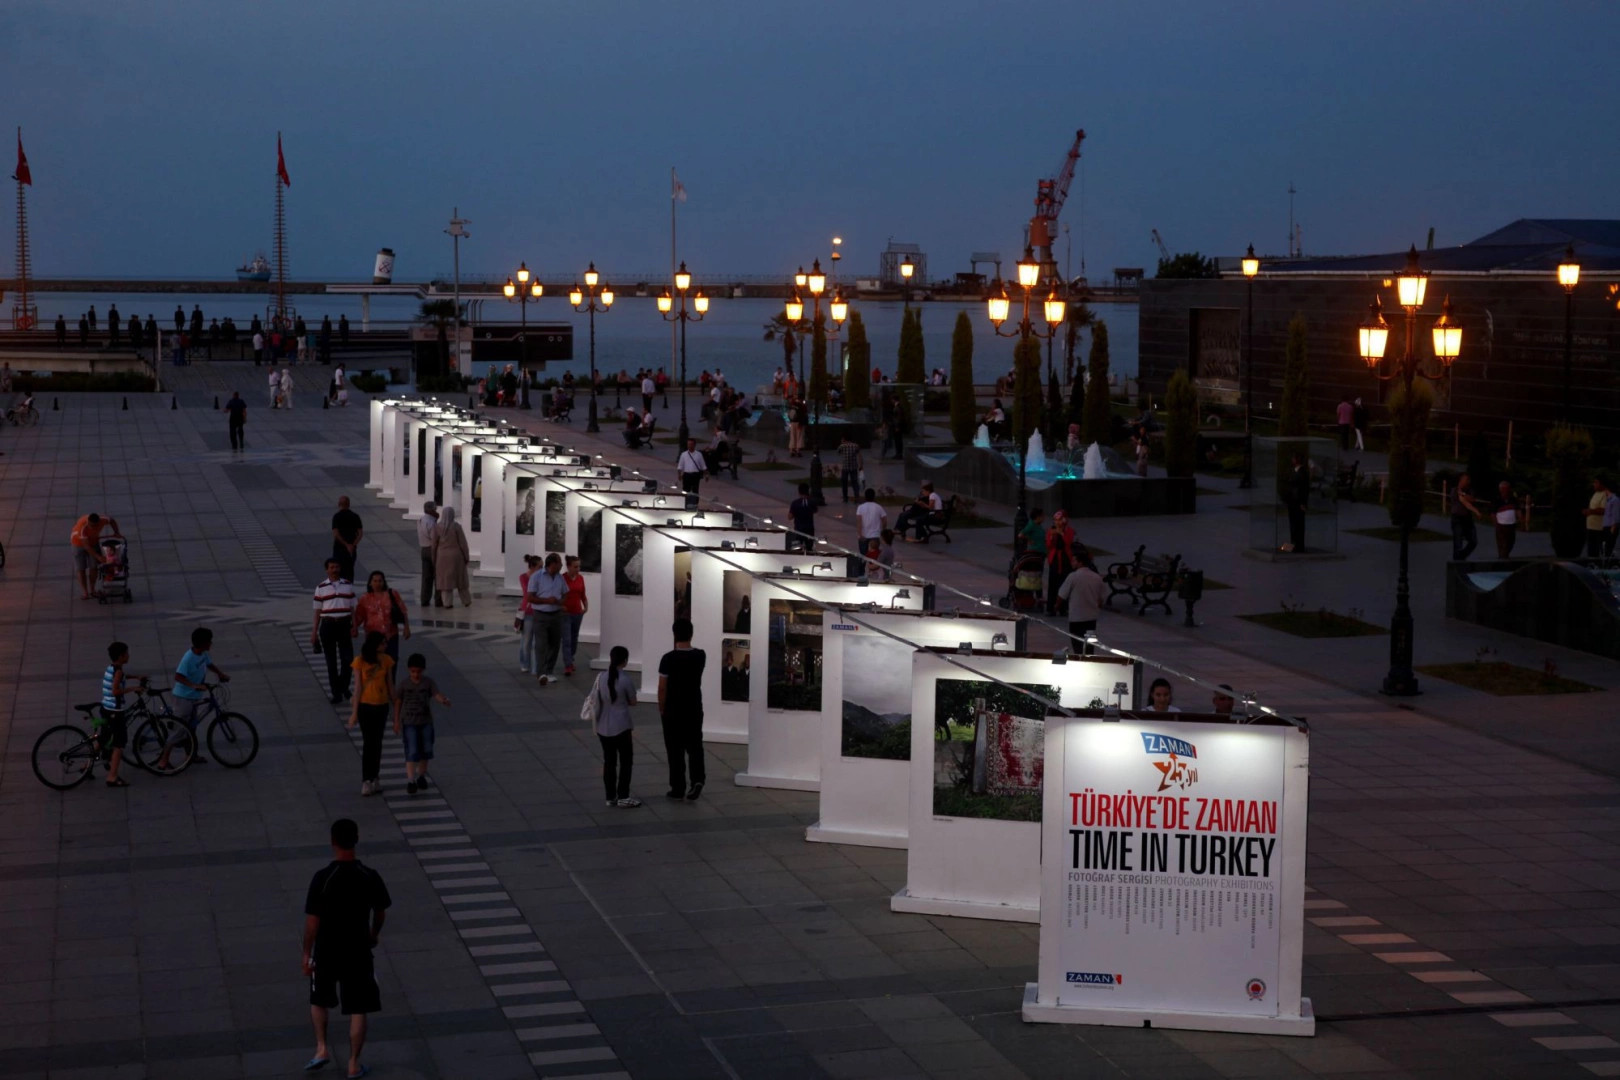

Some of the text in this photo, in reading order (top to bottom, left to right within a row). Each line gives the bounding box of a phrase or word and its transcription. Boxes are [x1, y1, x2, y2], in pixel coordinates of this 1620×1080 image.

[1144, 735, 1192, 756] ZAMAN
[1195, 799, 1277, 834] ZAMAN
[1069, 829, 1276, 877] TIME IN TURKEY
[1068, 871, 1115, 883] FOTOĞRAF
[1154, 875, 1218, 888] PHOTOGRAPHY
[1220, 879, 1274, 891] EXHIBITIONS
[1068, 973, 1110, 983] ZAMAN
